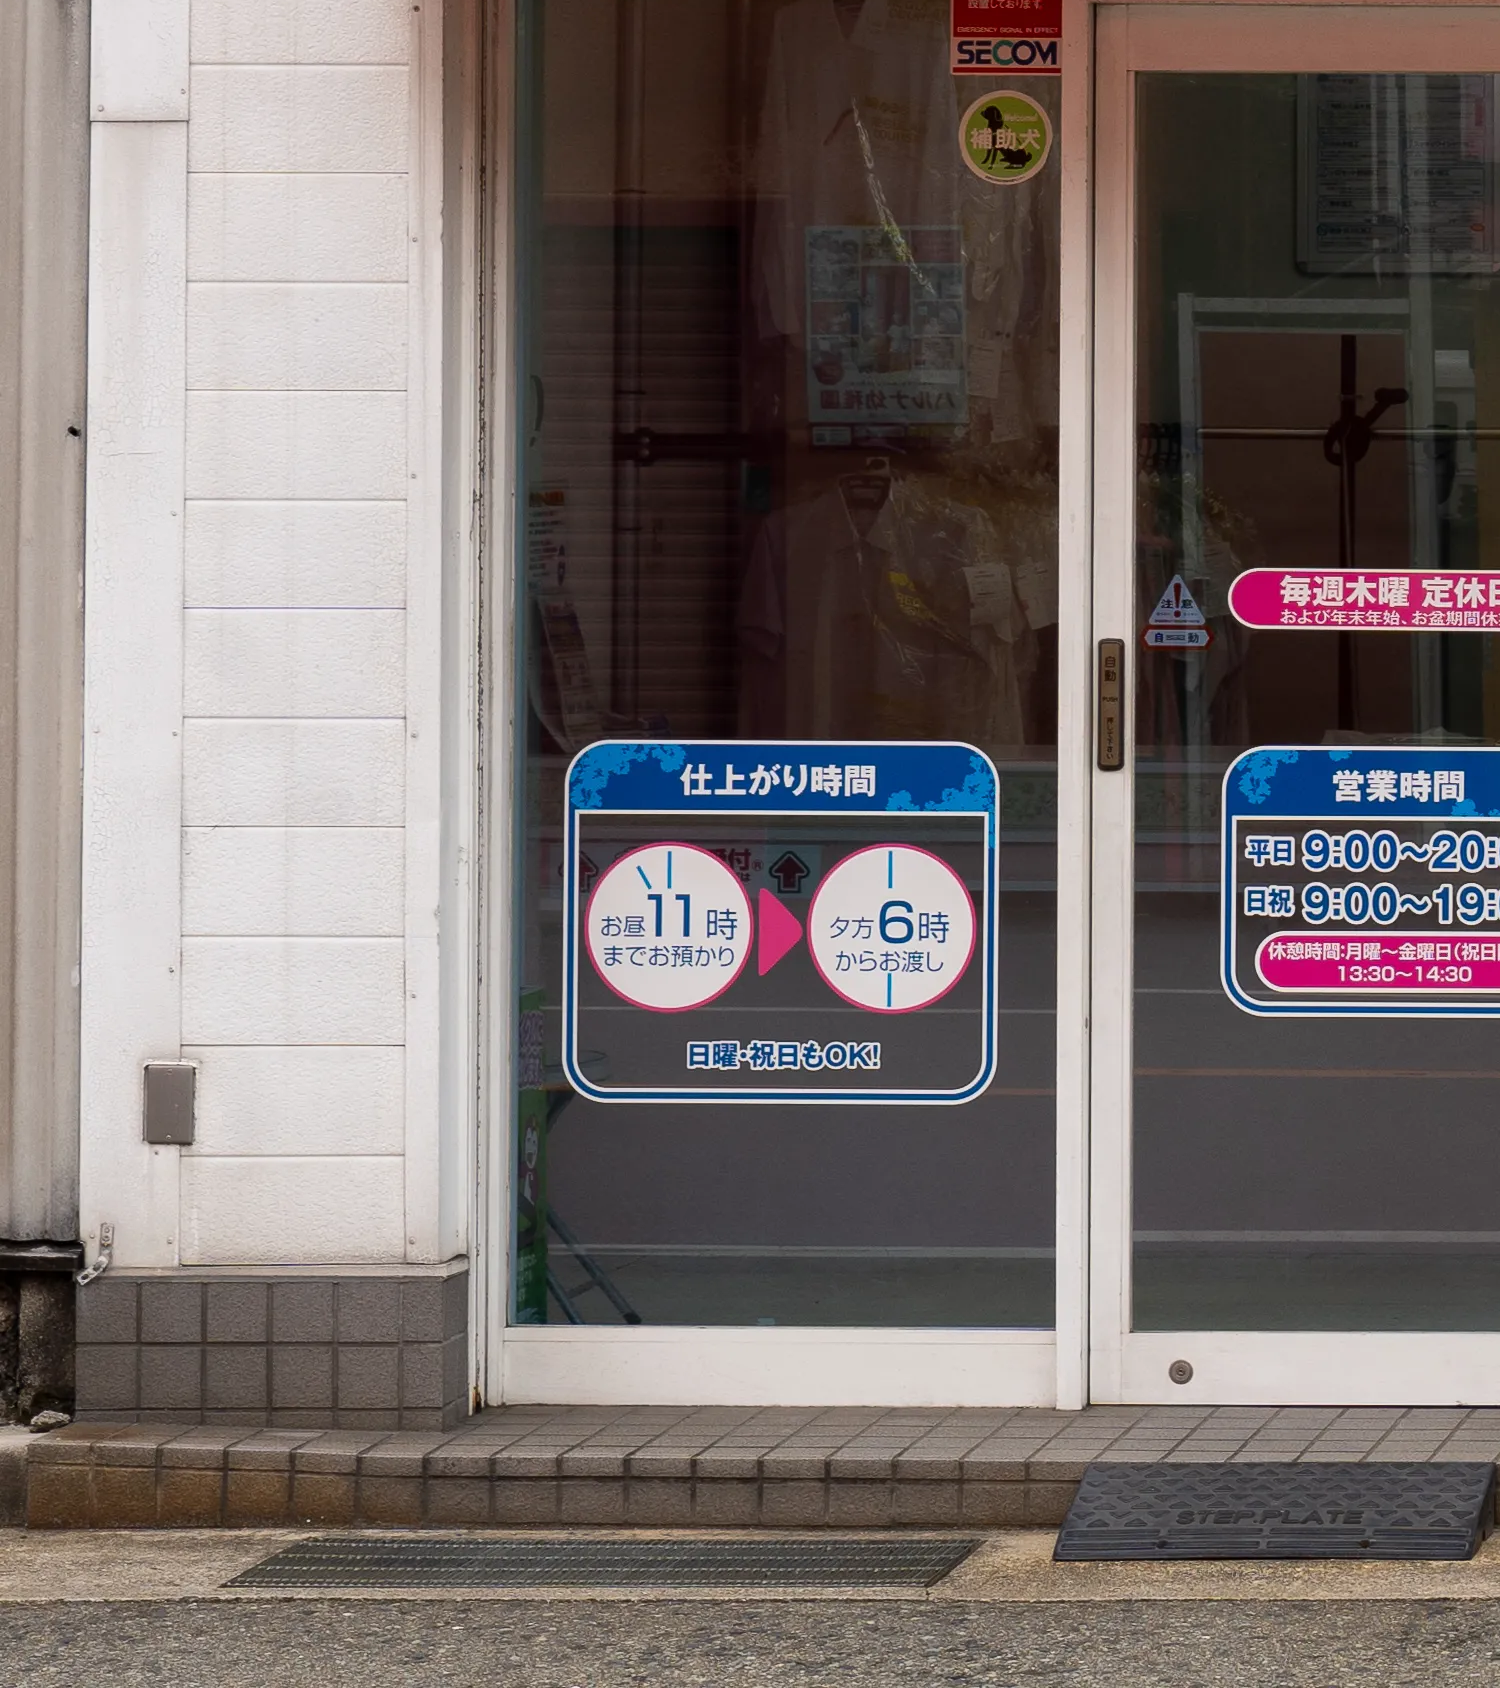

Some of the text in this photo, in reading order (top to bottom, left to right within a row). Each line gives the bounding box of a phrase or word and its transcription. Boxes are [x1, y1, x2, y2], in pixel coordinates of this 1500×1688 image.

[956, 26, 998, 34] EMERGENCY
[1033, 26, 1059, 34] EFFECT
[957, 40, 1058, 66] SECOM
[970, 127, 1041, 150] 補助犬
[1280, 576, 1411, 608] 毎週木曜
[1104, 656, 1117, 682] 自動
[1106, 717, 1115, 760] 押して下さい
[680, 763, 877, 798] 仕上がり時間
[1332, 769, 1466, 803] 営業時間
[1245, 835, 1295, 868] 平日
[600, 893, 738, 941] お昼11時
[1245, 886, 1295, 919] 日祝
[829, 900, 950, 945] 夕方6時
[602, 944, 736, 969] までお預かり
[835, 950, 945, 974] からお渡し
[1337, 965, 1473, 984] 13:30～14:30
[686, 1040, 881, 1071] 日曜・祝日もOK!
